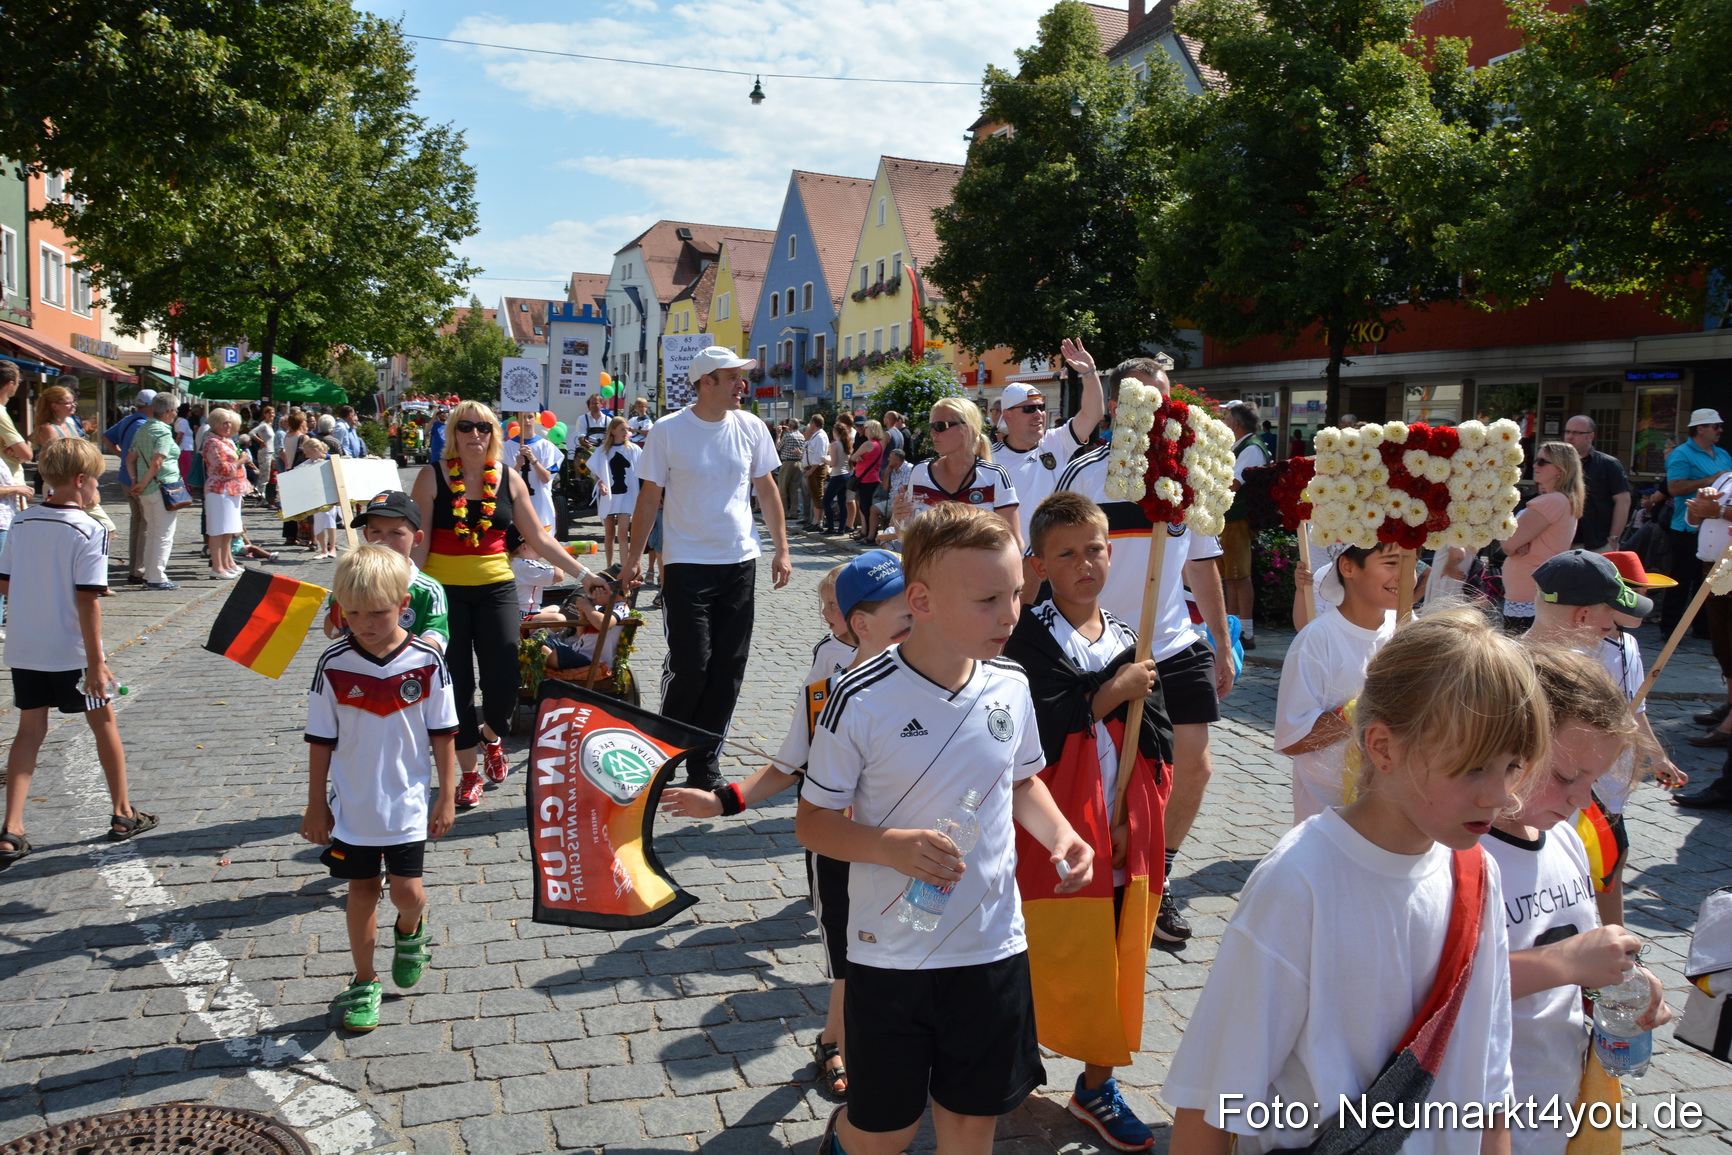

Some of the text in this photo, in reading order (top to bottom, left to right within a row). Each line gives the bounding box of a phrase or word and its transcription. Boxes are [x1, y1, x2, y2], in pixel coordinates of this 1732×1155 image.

[227, 350, 236, 362] P
[504, 366, 538, 380] SCHACHKLUB
[503, 387, 532, 403] NEUMARKT
[843, 385, 851, 398] P
[867, 559, 894, 577] DARTH
[900, 728, 929, 738] adidas
